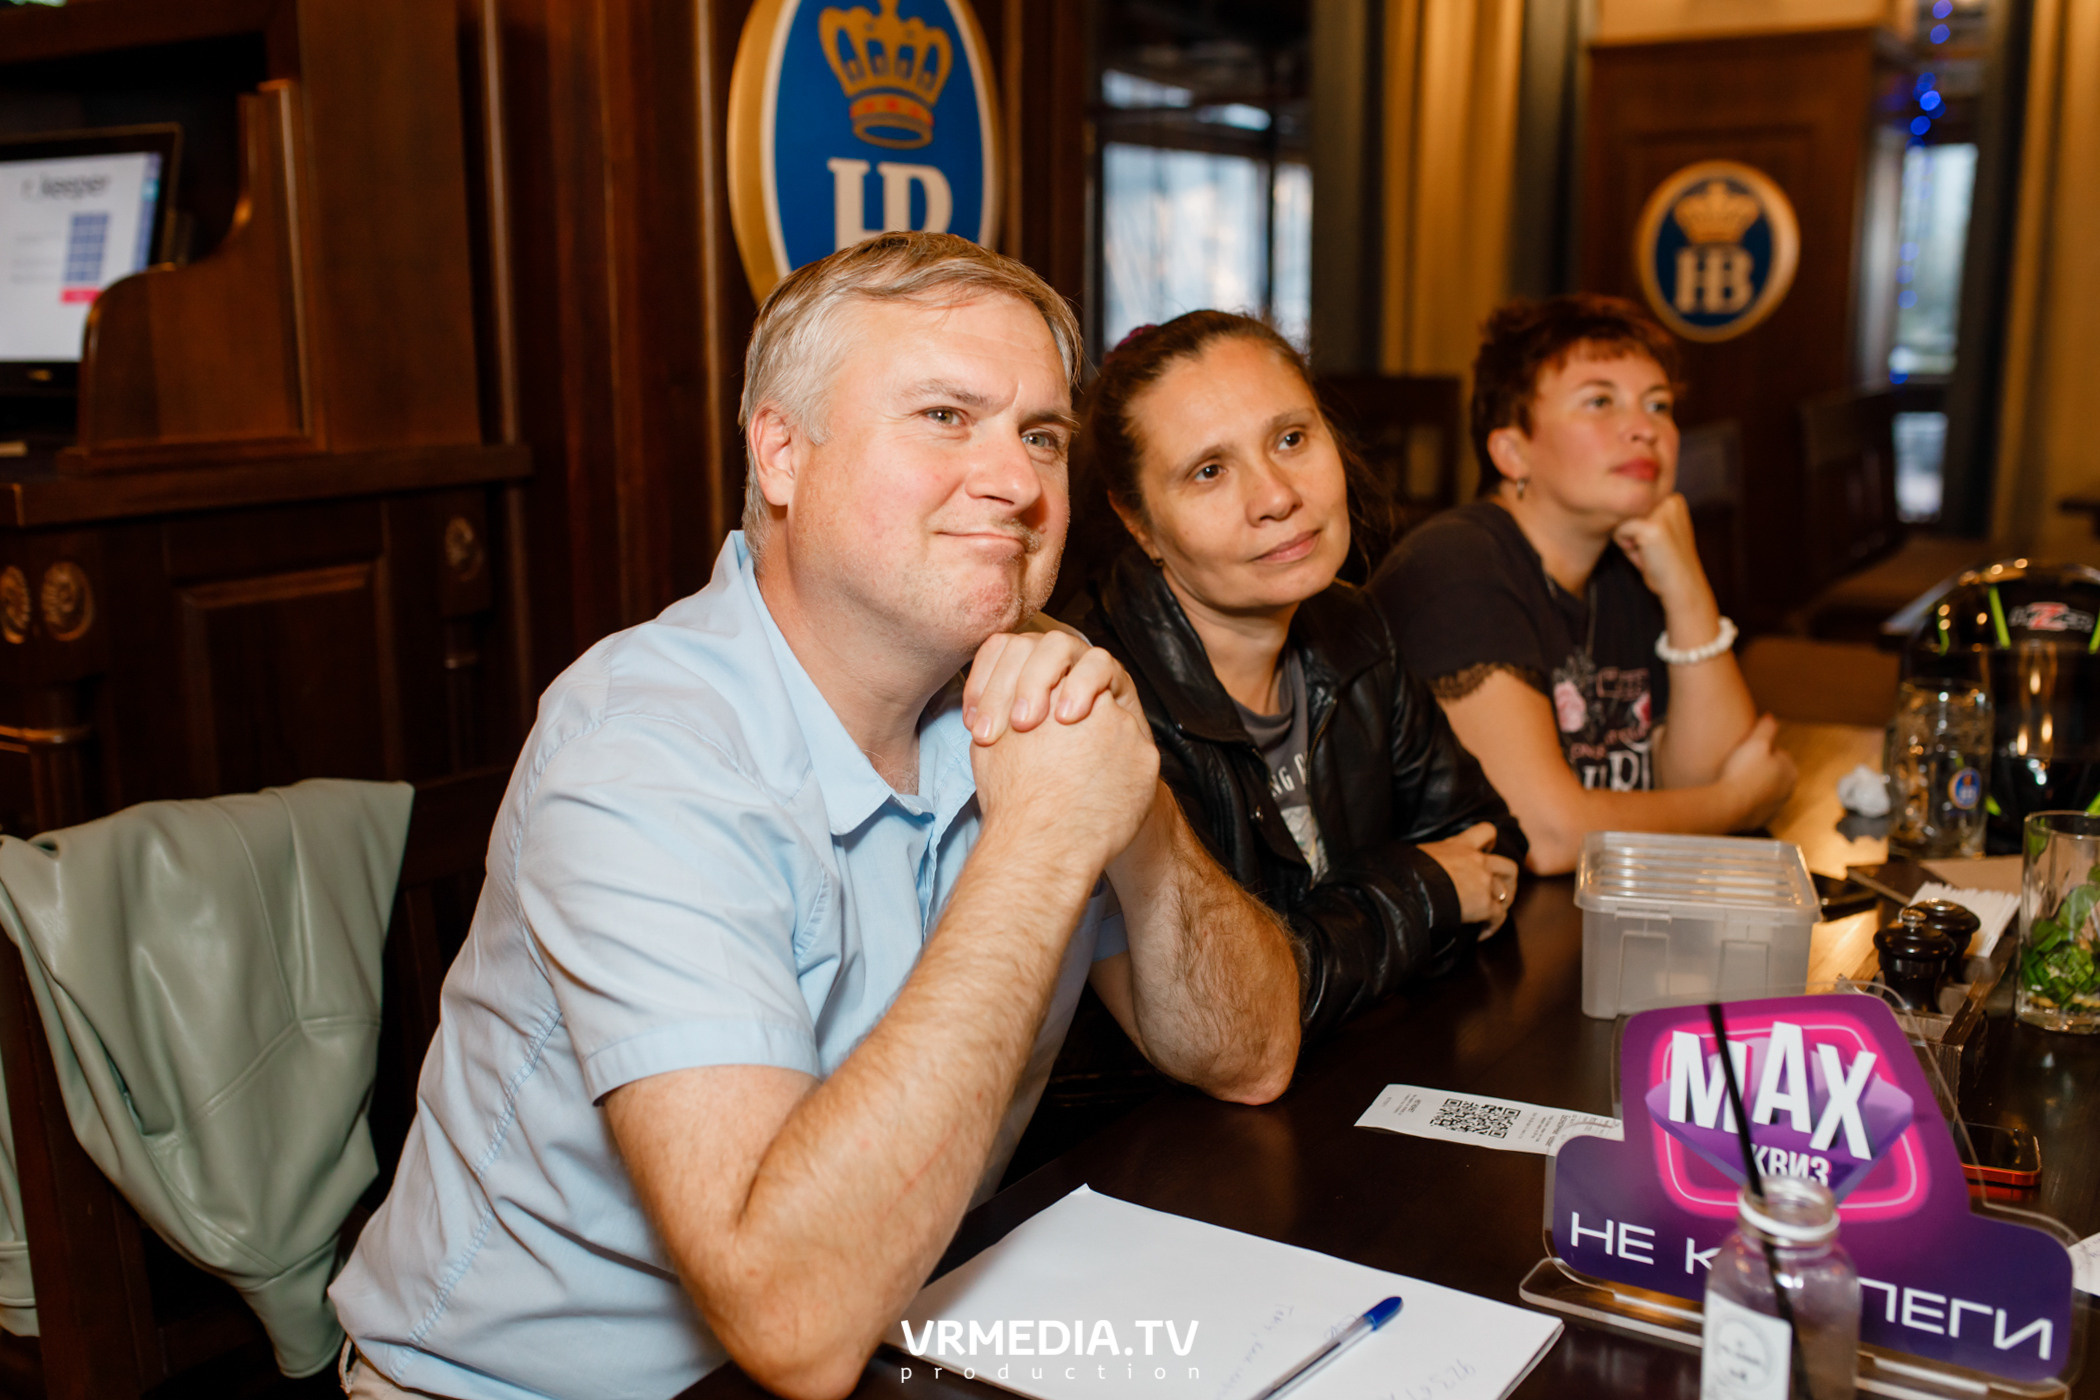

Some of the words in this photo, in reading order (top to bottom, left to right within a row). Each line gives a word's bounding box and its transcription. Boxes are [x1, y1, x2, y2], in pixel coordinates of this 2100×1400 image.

[1675, 247, 1753, 314] HB
[1669, 1021, 1877, 1161] MAX
[1570, 1211, 1656, 1266] НЕ
[1685, 1237, 2053, 1360] КЛЕГИ
